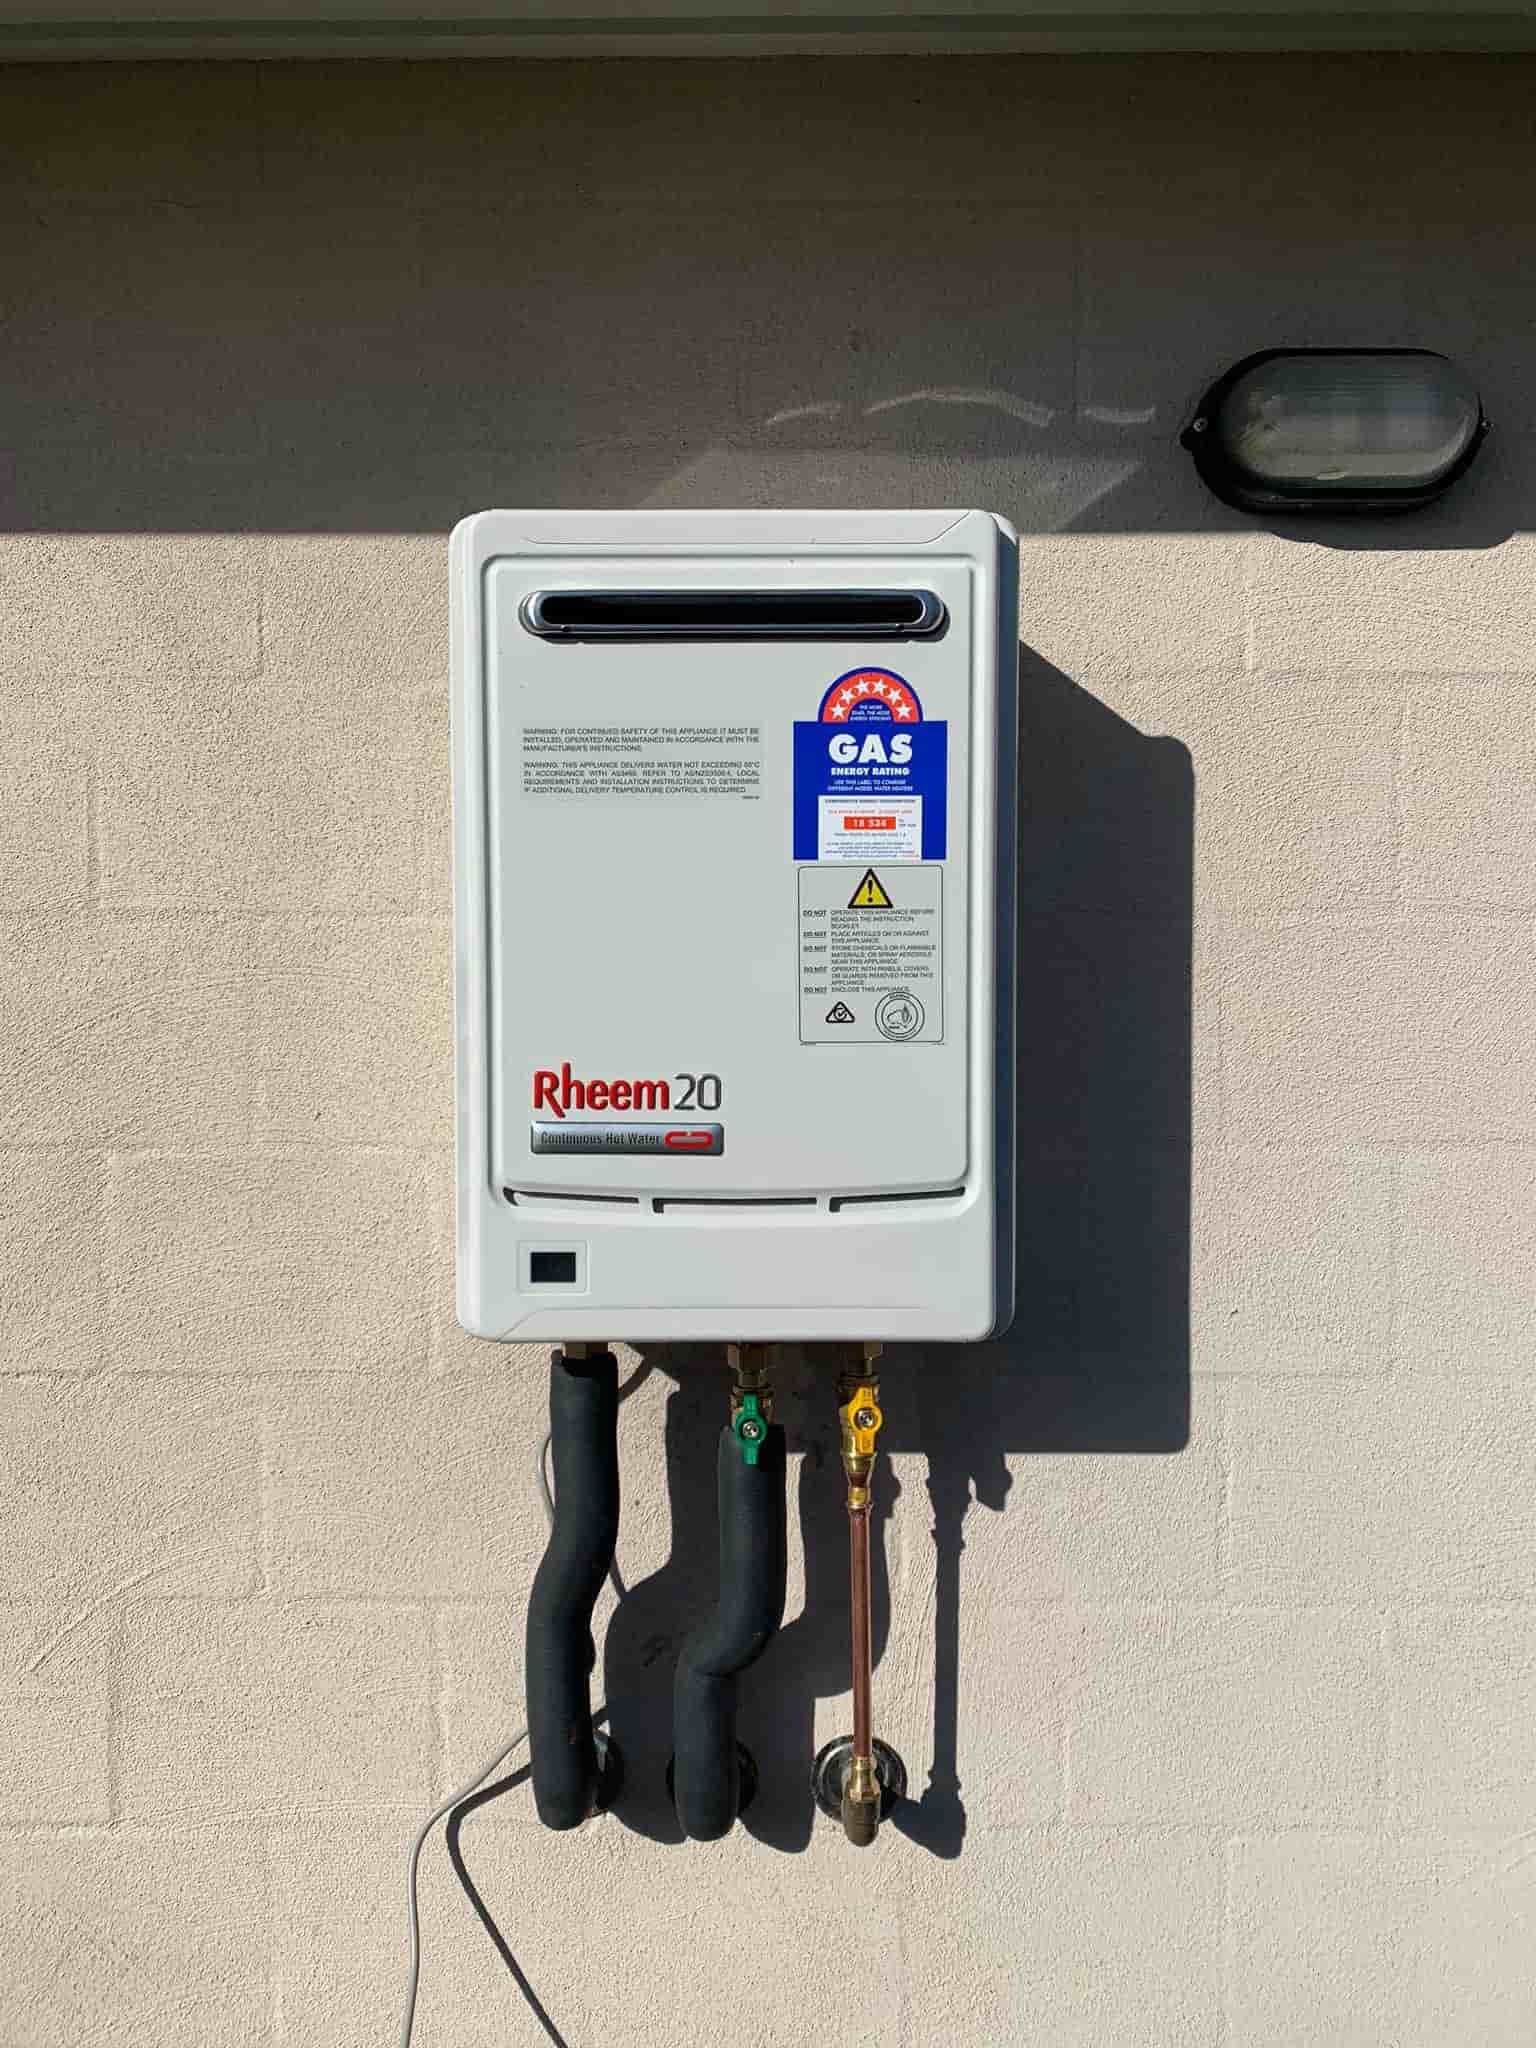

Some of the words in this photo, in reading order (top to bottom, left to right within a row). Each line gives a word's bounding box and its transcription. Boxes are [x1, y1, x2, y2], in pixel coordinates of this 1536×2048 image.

[829, 733, 912, 764] GAS
[534, 1063, 670, 1118] Rheem
[674, 1074, 721, 1110] 20
[541, 1132, 601, 1145] Continuous
[606, 1132, 625, 1145] Hot
[627, 1132, 660, 1145] Water
